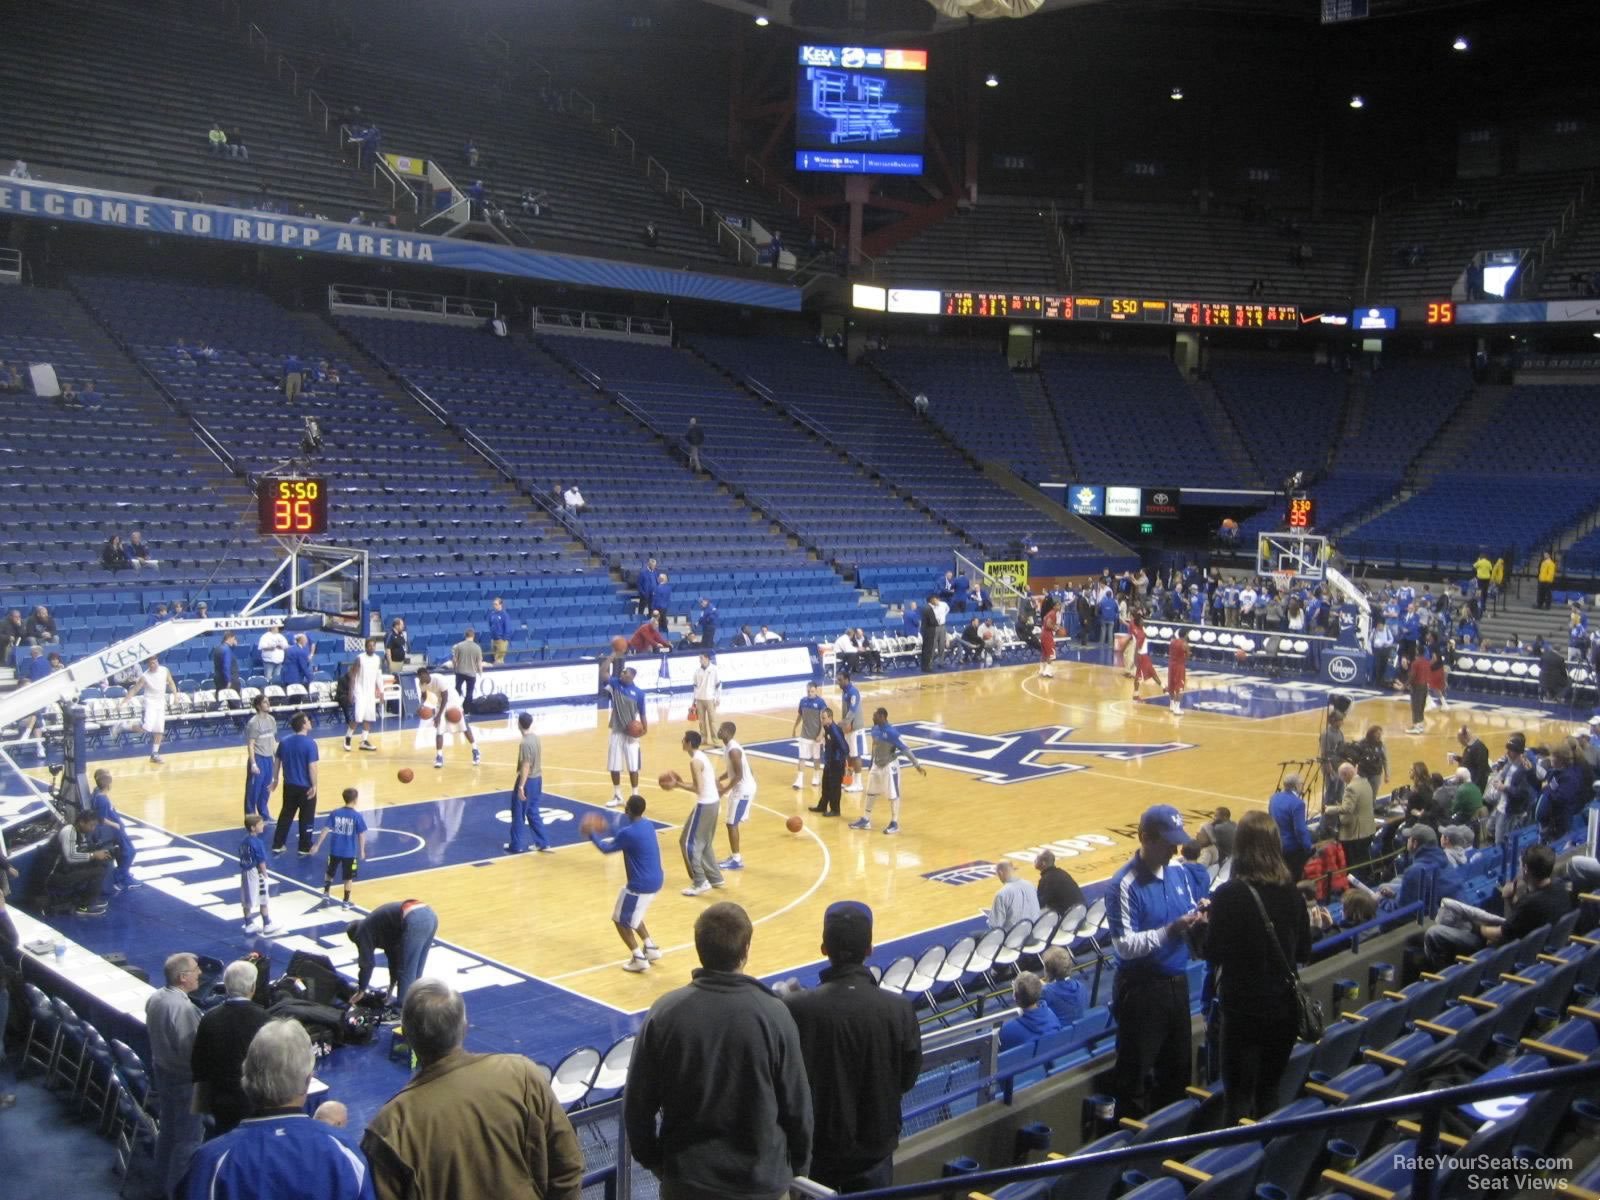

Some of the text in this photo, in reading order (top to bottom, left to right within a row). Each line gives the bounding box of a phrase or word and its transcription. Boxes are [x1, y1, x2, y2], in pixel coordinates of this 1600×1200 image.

[172, 209, 211, 233] TO
[233, 218, 320, 247] RUPP
[336, 231, 434, 262] ARENA
[1112, 299, 1137, 313] 5:50
[1428, 303, 1451, 323] 35
[279, 482, 318, 500] 5:50
[275, 500, 312, 529] 35
[1146, 505, 1176, 513] TOYOTA
[214, 616, 286, 630] KENTUCKY
[98, 642, 151, 674] KESA
[1332, 660, 1354, 678] Kroger
